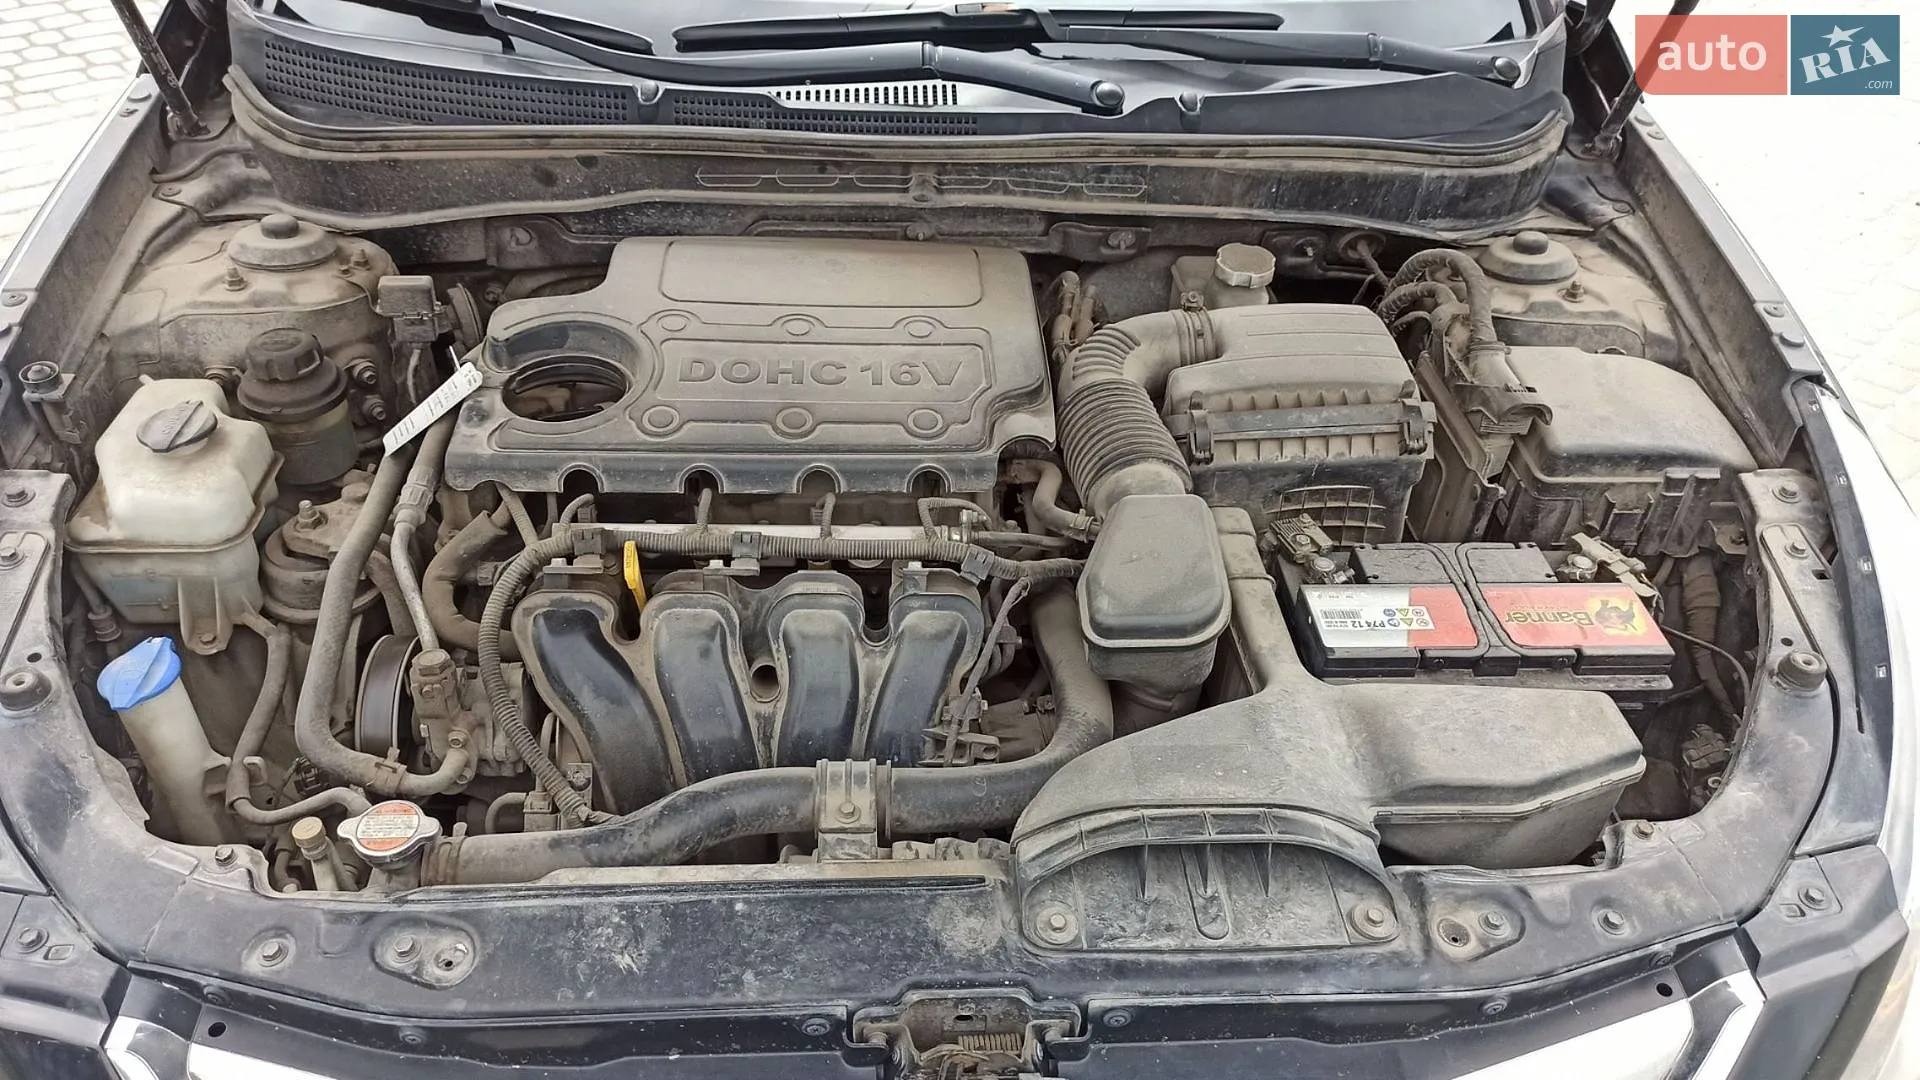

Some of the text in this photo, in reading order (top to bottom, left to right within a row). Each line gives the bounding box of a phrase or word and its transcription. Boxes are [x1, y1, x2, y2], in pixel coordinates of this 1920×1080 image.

[678, 357, 963, 386] DOHC 16V
[1505, 610, 1594, 626] Banner
